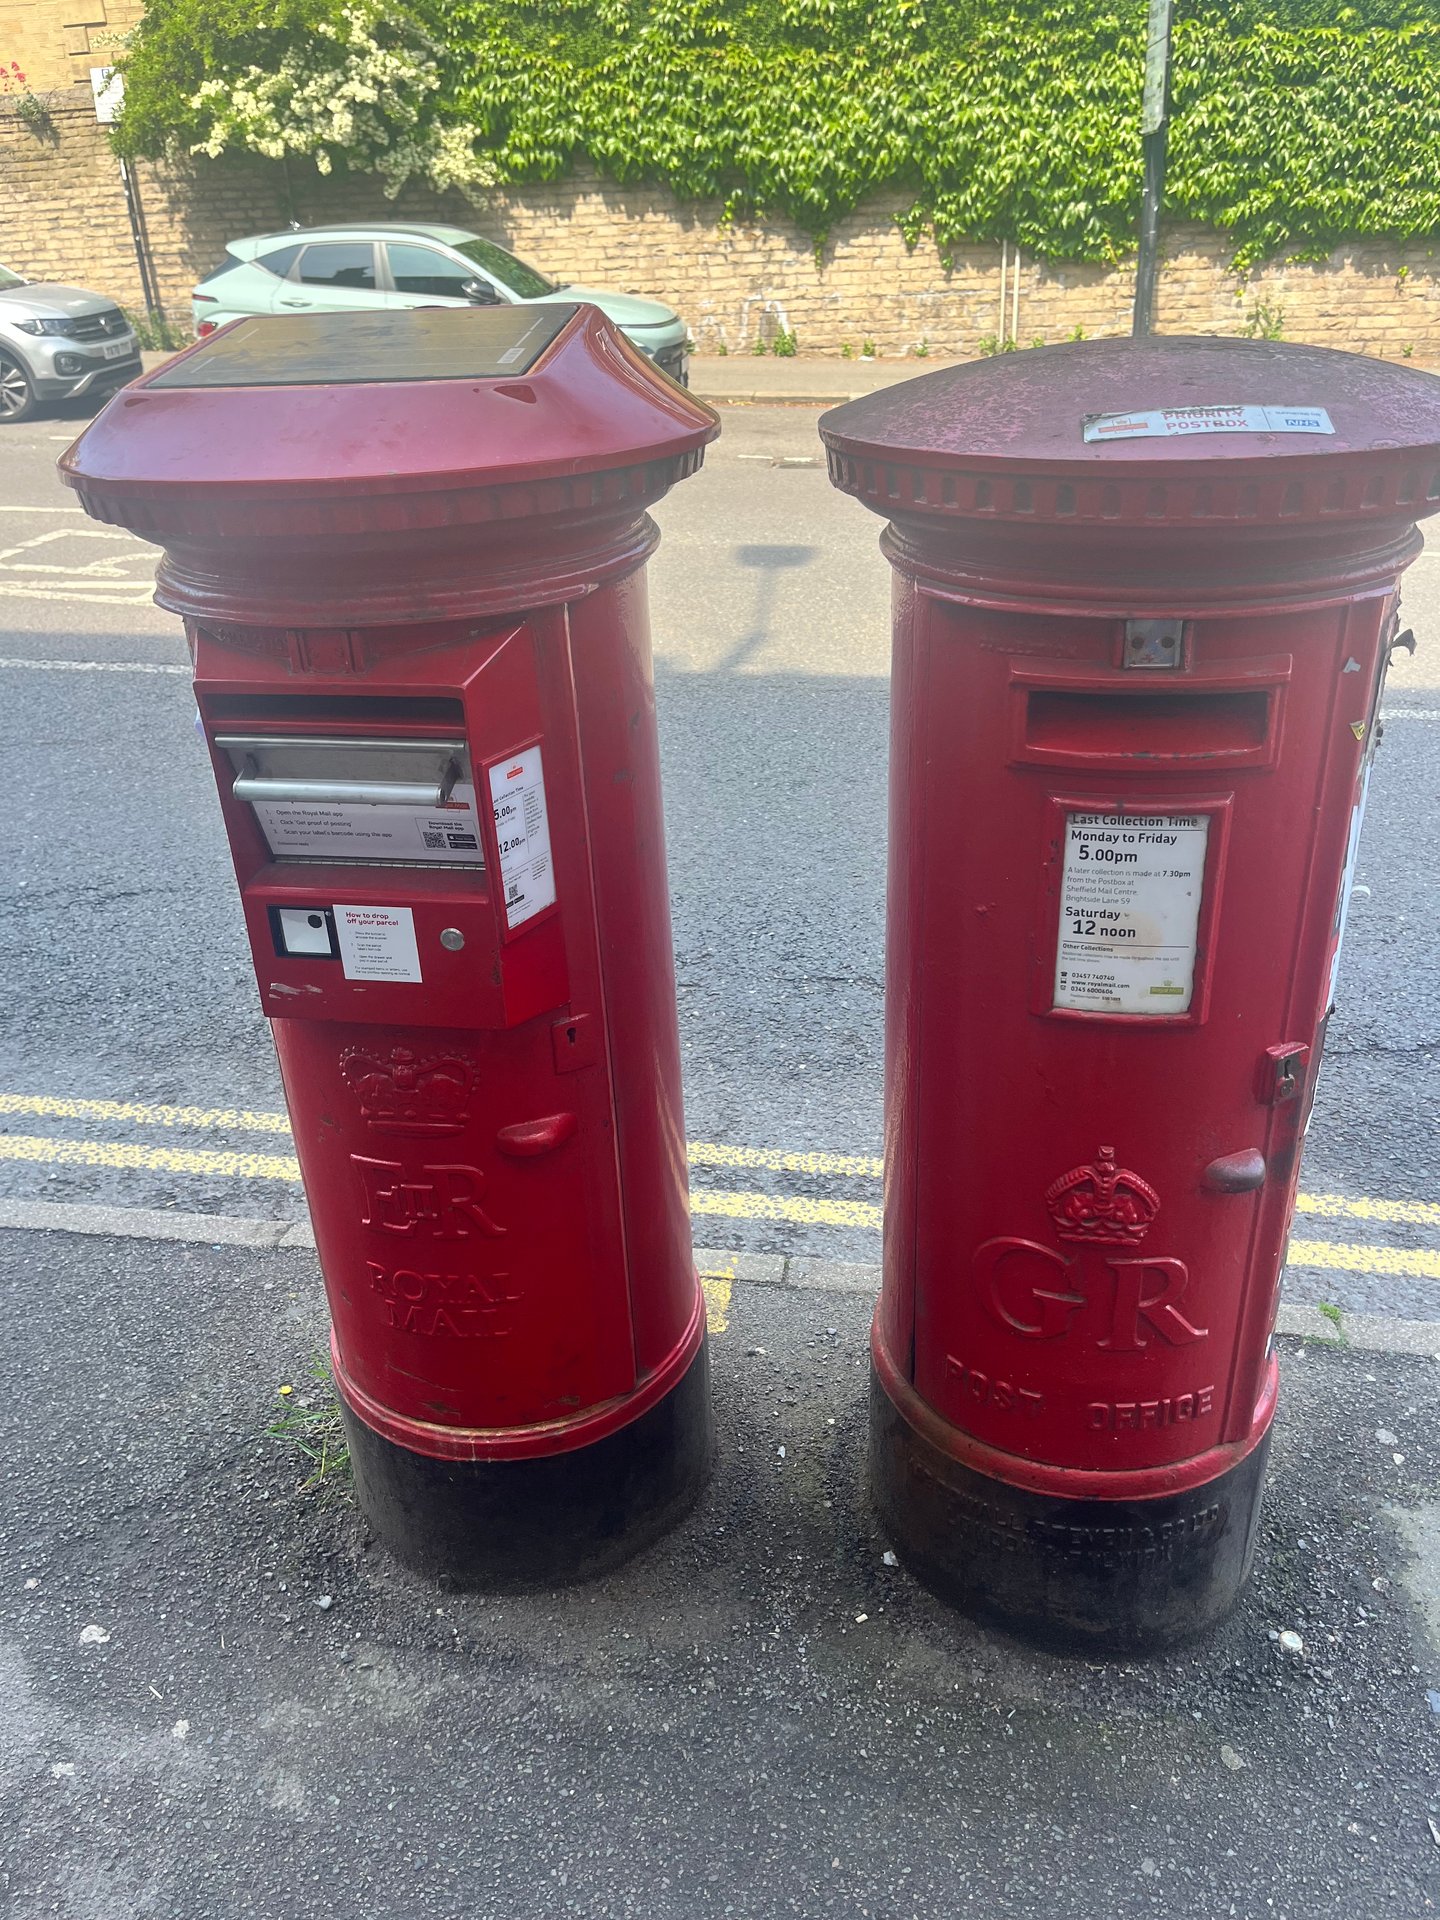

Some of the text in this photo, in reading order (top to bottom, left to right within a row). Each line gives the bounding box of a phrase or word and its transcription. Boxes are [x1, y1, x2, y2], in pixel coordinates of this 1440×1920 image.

[1166, 420, 1249, 430] POSTBOX
[1072, 814, 1198, 827] Last Collection Time
[1072, 830, 1177, 845] Monday to Friday
[1079, 845, 1137, 864] 5.00pm
[1091, 868, 1124, 876] collection
[1162, 870, 1190, 878] 7.30pm
[1066, 885, 1096, 894] Sheffield
[1066, 895, 1100, 903] Brightside
[1065, 906, 1120, 921] Saturday
[1073, 920, 1136, 937] 12 noon
[1071, 980, 1129, 988] www.royalmail.com
[366, 1261, 524, 1302] ROYAL
[973, 1236, 1209, 1352] GR
[384, 1299, 513, 1337] MAIL
[944, 1353, 1214, 1431] POST OFFICE
